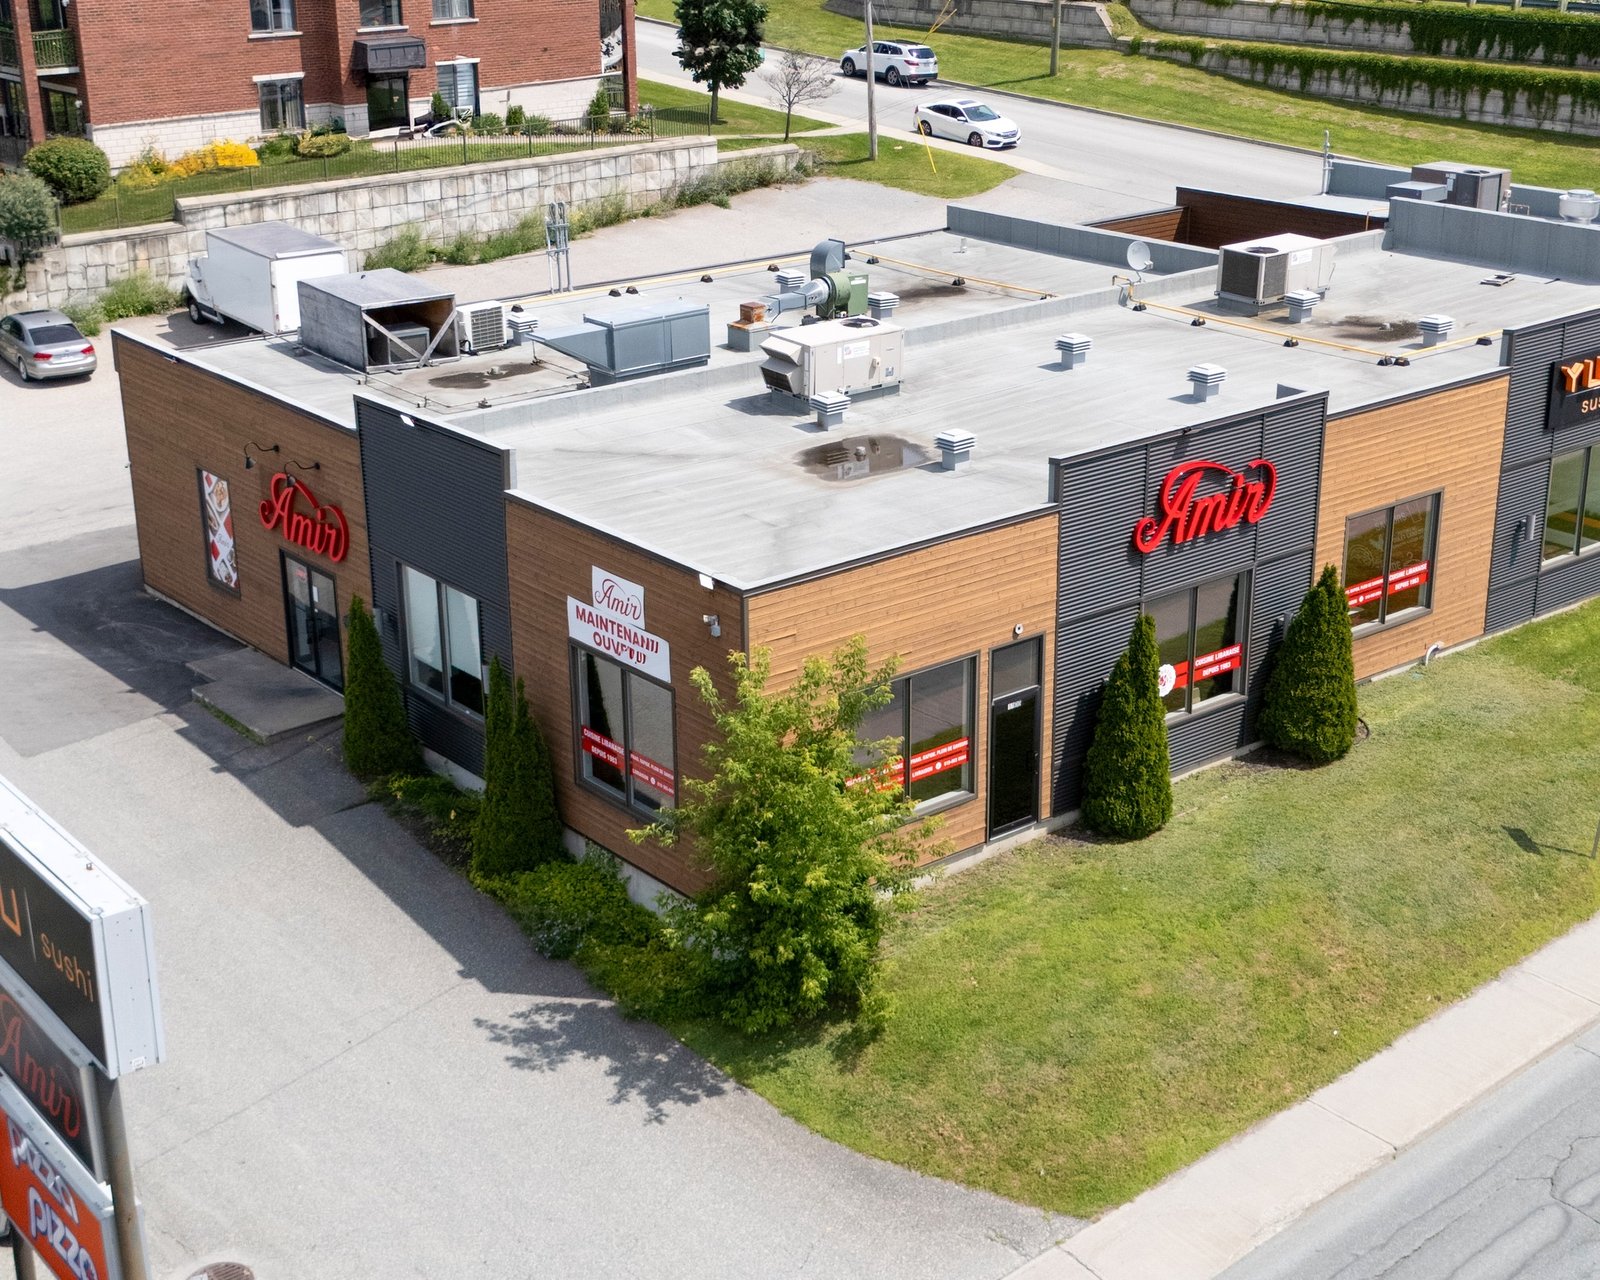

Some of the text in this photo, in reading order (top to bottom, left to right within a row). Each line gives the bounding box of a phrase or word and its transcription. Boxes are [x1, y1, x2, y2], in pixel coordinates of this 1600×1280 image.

[1561, 356, 1600, 393] YL
[1581, 397, 1600, 413] su
[258, 472, 350, 565] Amir
[1132, 459, 1278, 554] Amir
[594, 578, 642, 620] Amir
[41, 931, 94, 1002] sushi
